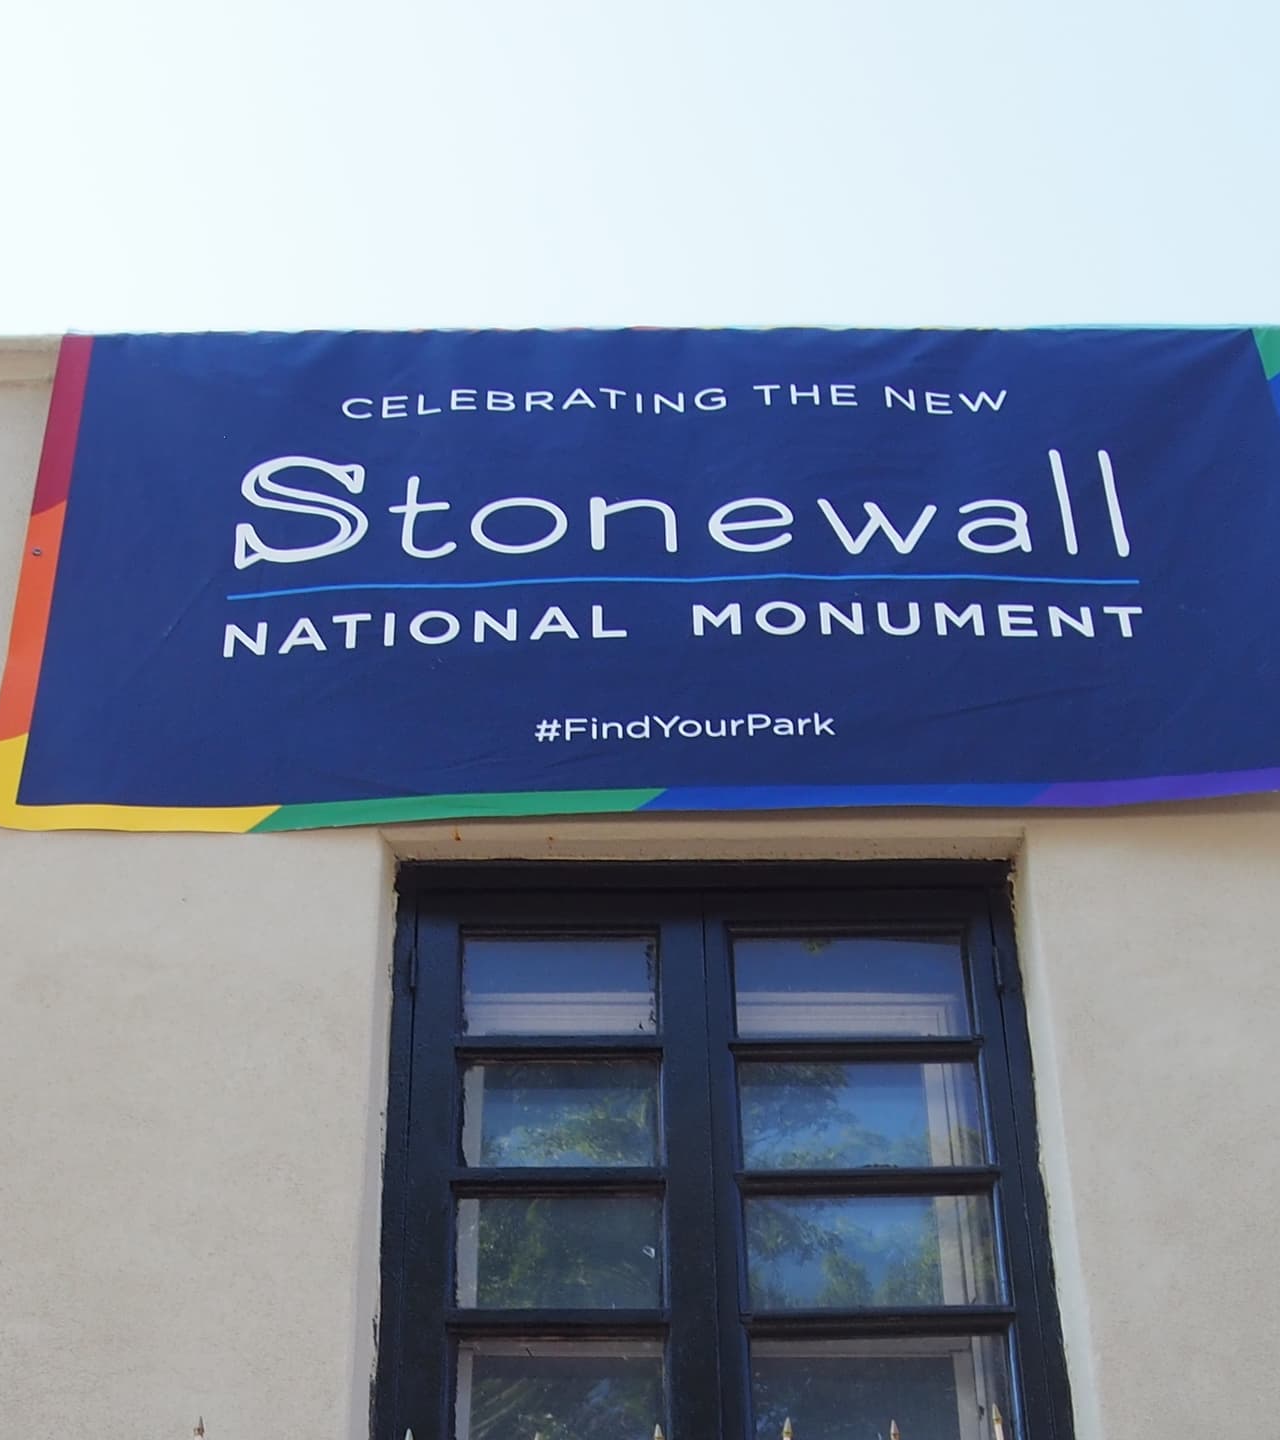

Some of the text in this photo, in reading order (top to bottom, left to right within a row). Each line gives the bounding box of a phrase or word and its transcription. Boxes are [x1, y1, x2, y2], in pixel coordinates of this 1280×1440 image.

[340, 382, 1008, 420] CELEBRATING THE NEW
[232, 448, 1131, 572] Stonewall
[222, 600, 1144, 660] NATIONAL MONUMENT
[533, 711, 836, 743] #FindYourPark
